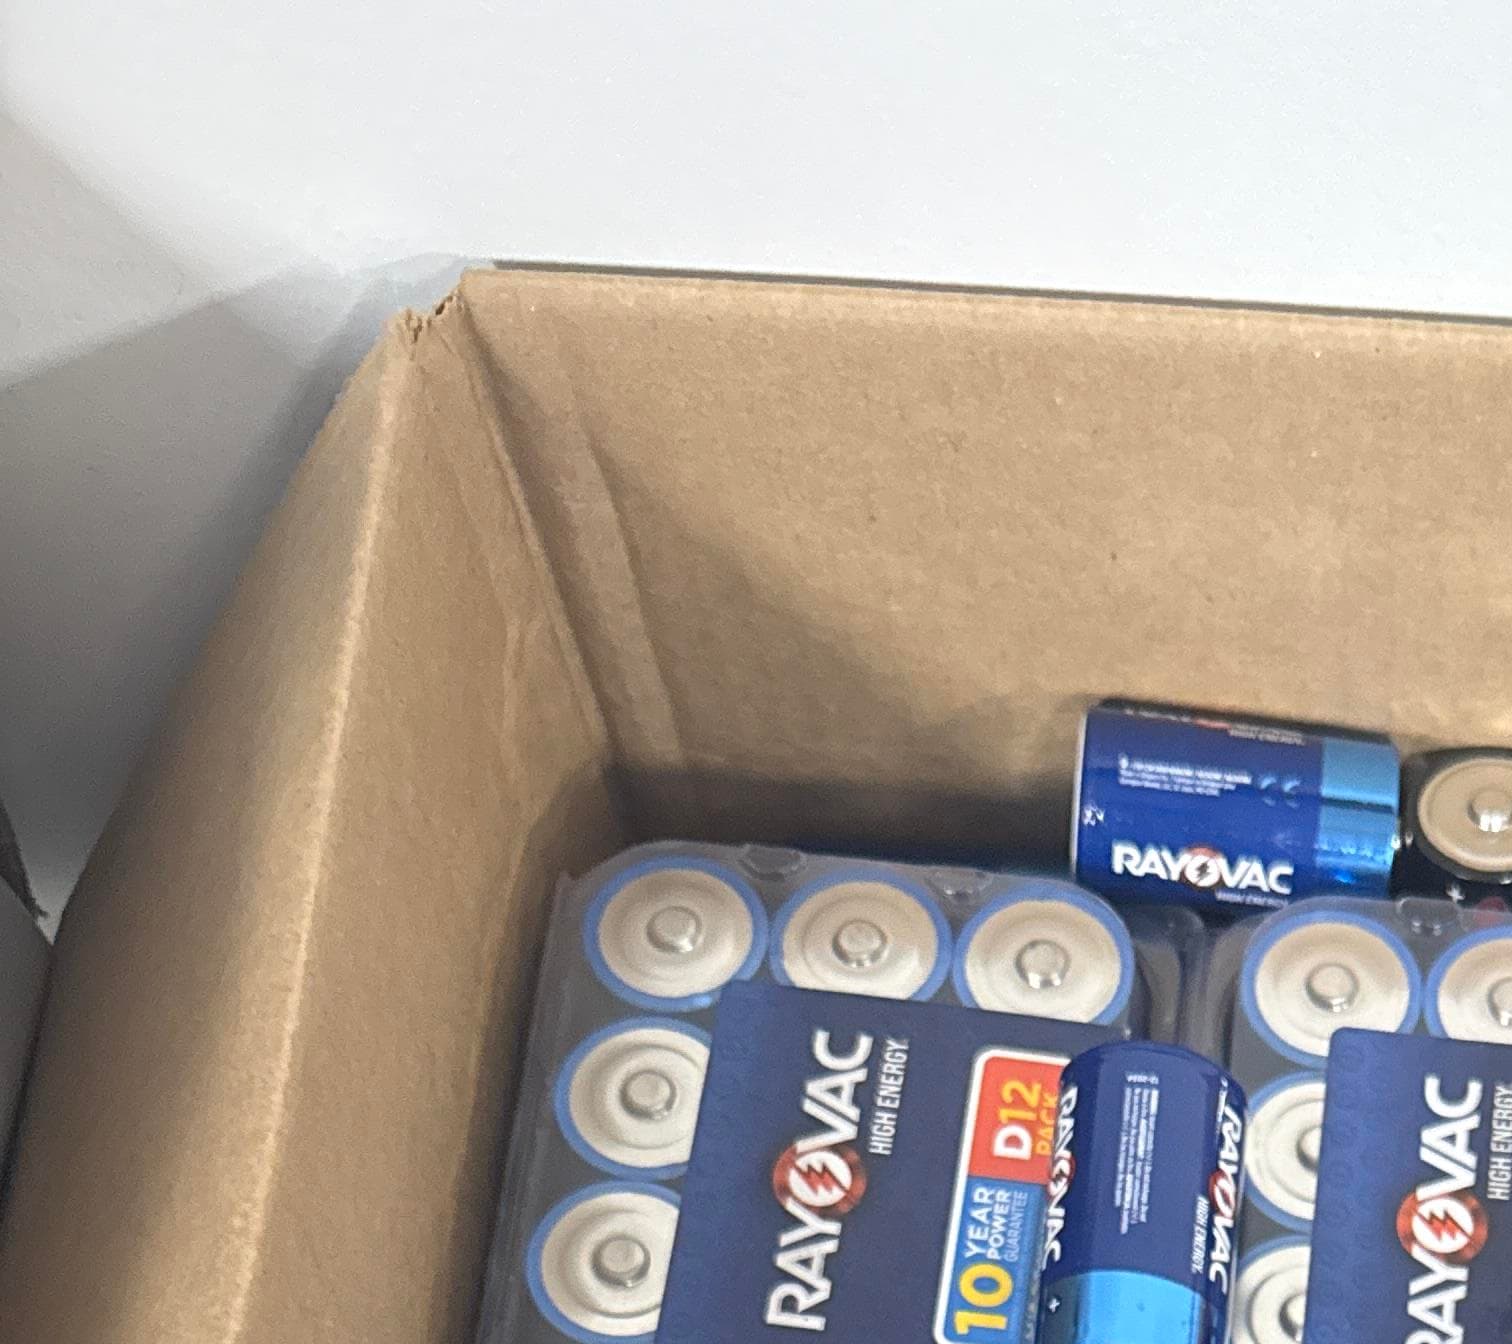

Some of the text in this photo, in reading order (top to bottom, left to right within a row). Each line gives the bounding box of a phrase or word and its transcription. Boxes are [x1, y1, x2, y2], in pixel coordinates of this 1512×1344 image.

[1111, 840, 1295, 894] RAYOVAC
[869, 1037, 910, 1156] HIGH ENERGY
[993, 1079, 1042, 1160] D12
[764, 1028, 874, 1332] RAYOVAC
[986, 1190, 1013, 1261] POWER
[1004, 1190, 1029, 1263] GUARANTEE
[1207, 1103, 1244, 1295] RAYOVAC
[954, 1186, 1014, 1336] 10 YEAR
